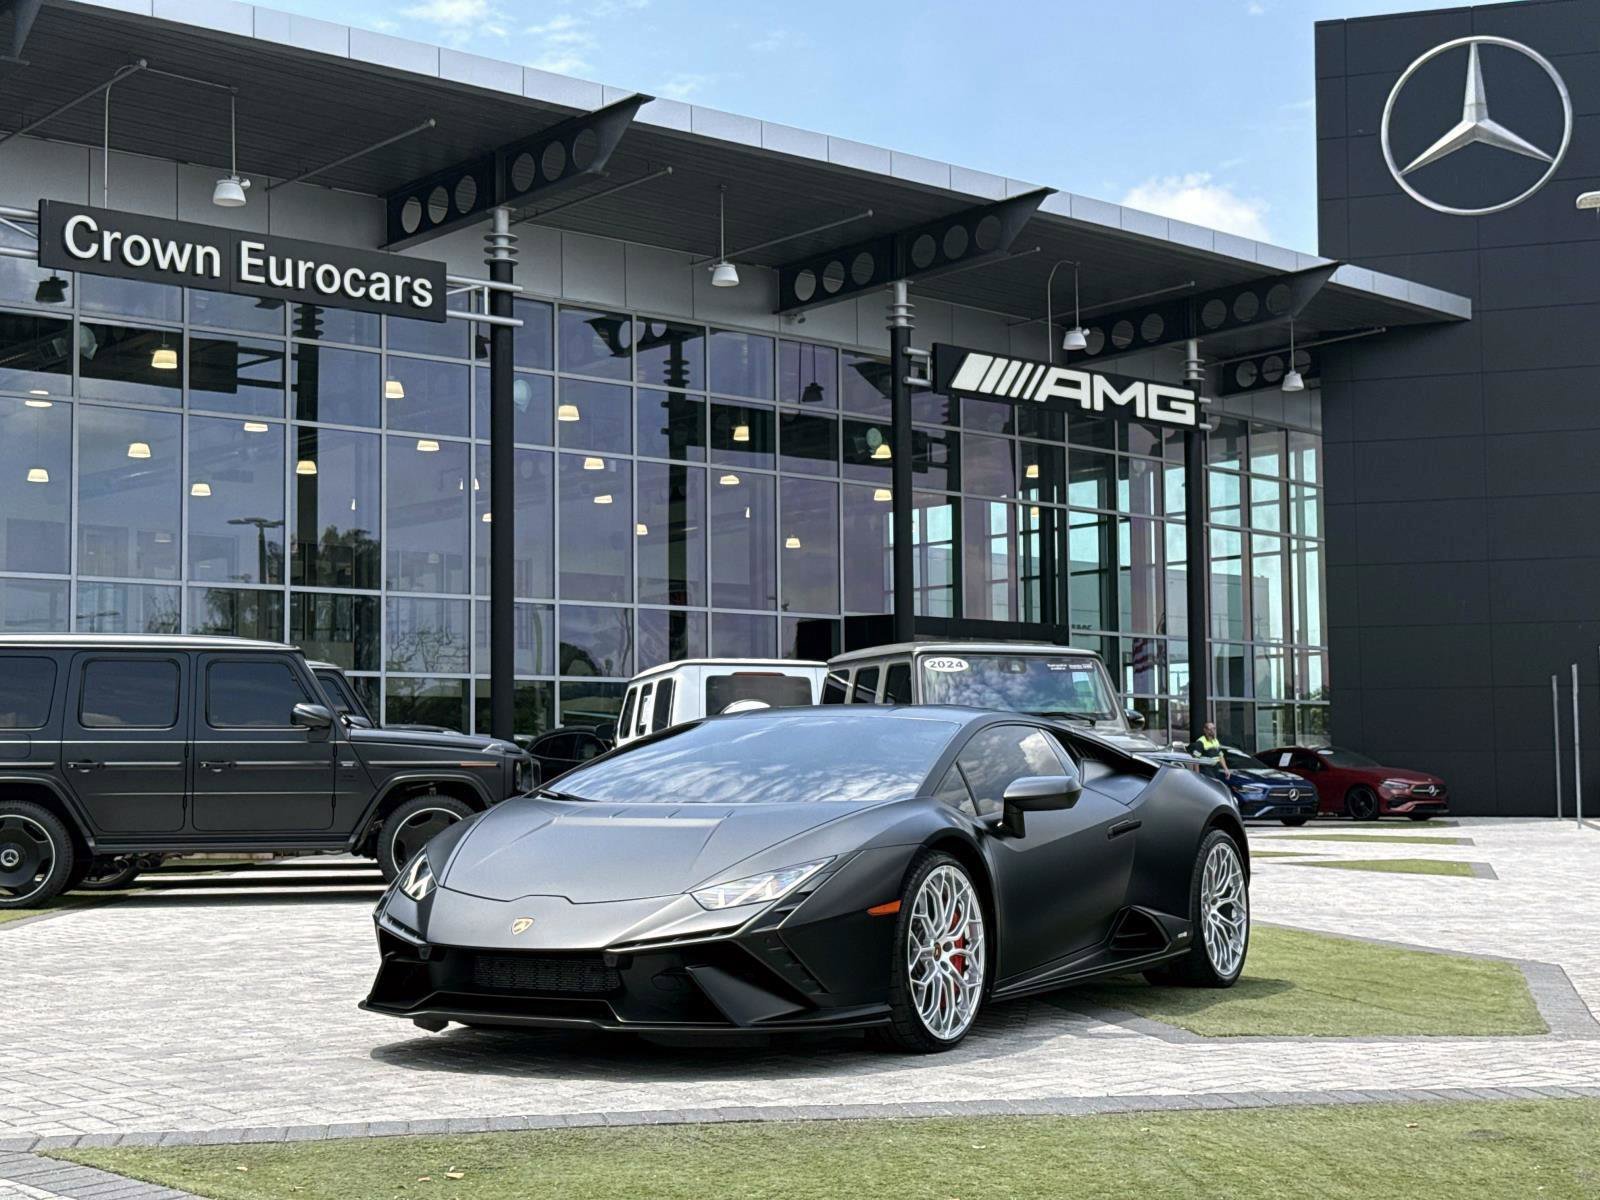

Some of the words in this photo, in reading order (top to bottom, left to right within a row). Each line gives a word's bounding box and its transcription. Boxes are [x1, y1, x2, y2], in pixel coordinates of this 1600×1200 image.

[63, 214, 221, 278] Crown
[239, 240, 434, 308] Eurocars
[928, 660, 964, 669] 2024
